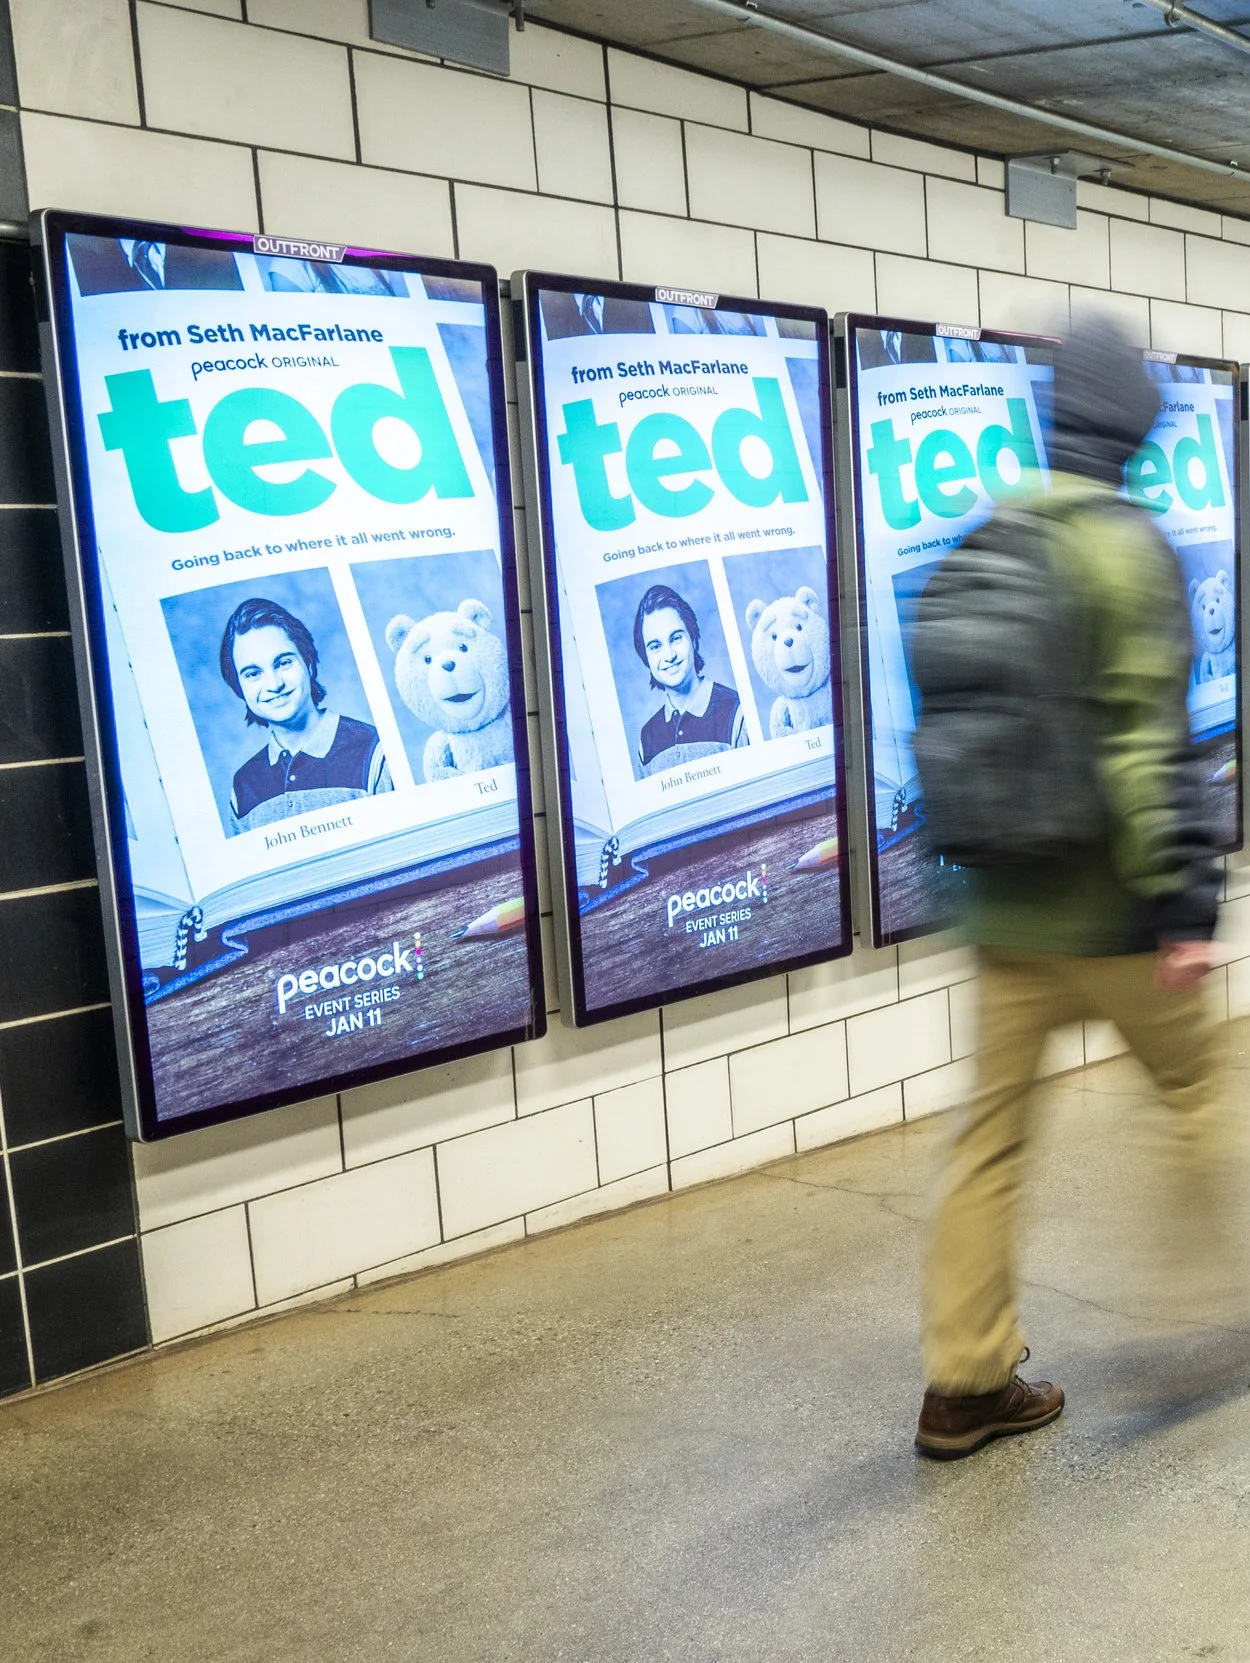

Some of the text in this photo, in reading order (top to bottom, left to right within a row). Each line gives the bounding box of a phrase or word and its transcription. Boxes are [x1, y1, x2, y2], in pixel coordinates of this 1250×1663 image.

[257, 238, 340, 259] OUTFRONT
[658, 289, 714, 307] OUTFRONT
[118, 323, 384, 351] from Seth MacFarlane
[938, 324, 980, 339] OUTFRONT
[191, 353, 340, 381] peacock ORIGINAL
[571, 359, 749, 384] from Seth MacFarlane
[618, 384, 719, 408] peacock ORIGINAL
[877, 383, 1004, 406] from Seth MacFarlane
[910, 405, 982, 426] peacock ORIGINAL
[97, 346, 476, 534] ted
[557, 377, 809, 532] ted
[866, 398, 1041, 531] ted
[1126, 413, 1226, 519] ed
[171, 525, 456, 572] Going back to where it all went wrong.
[603, 526, 796, 563] Going back to where it all went wrong.
[897, 544, 921, 556] Going
[922, 538, 941, 550] back
[942, 537, 951, 545] to
[805, 737, 822, 751] Ted
[473, 778, 499, 796] Ted
[660, 764, 722, 792] John Bennett
[263, 815, 355, 851] John Bennett
[667, 870, 760, 928] peacock
[685, 908, 752, 934] EVENT SERIES
[699, 925, 739, 948] JAN 11
[278, 941, 414, 1014] peacock
[304, 985, 401, 1020] EVENT SERIES
[325, 1011, 382, 1038] JAN 11
